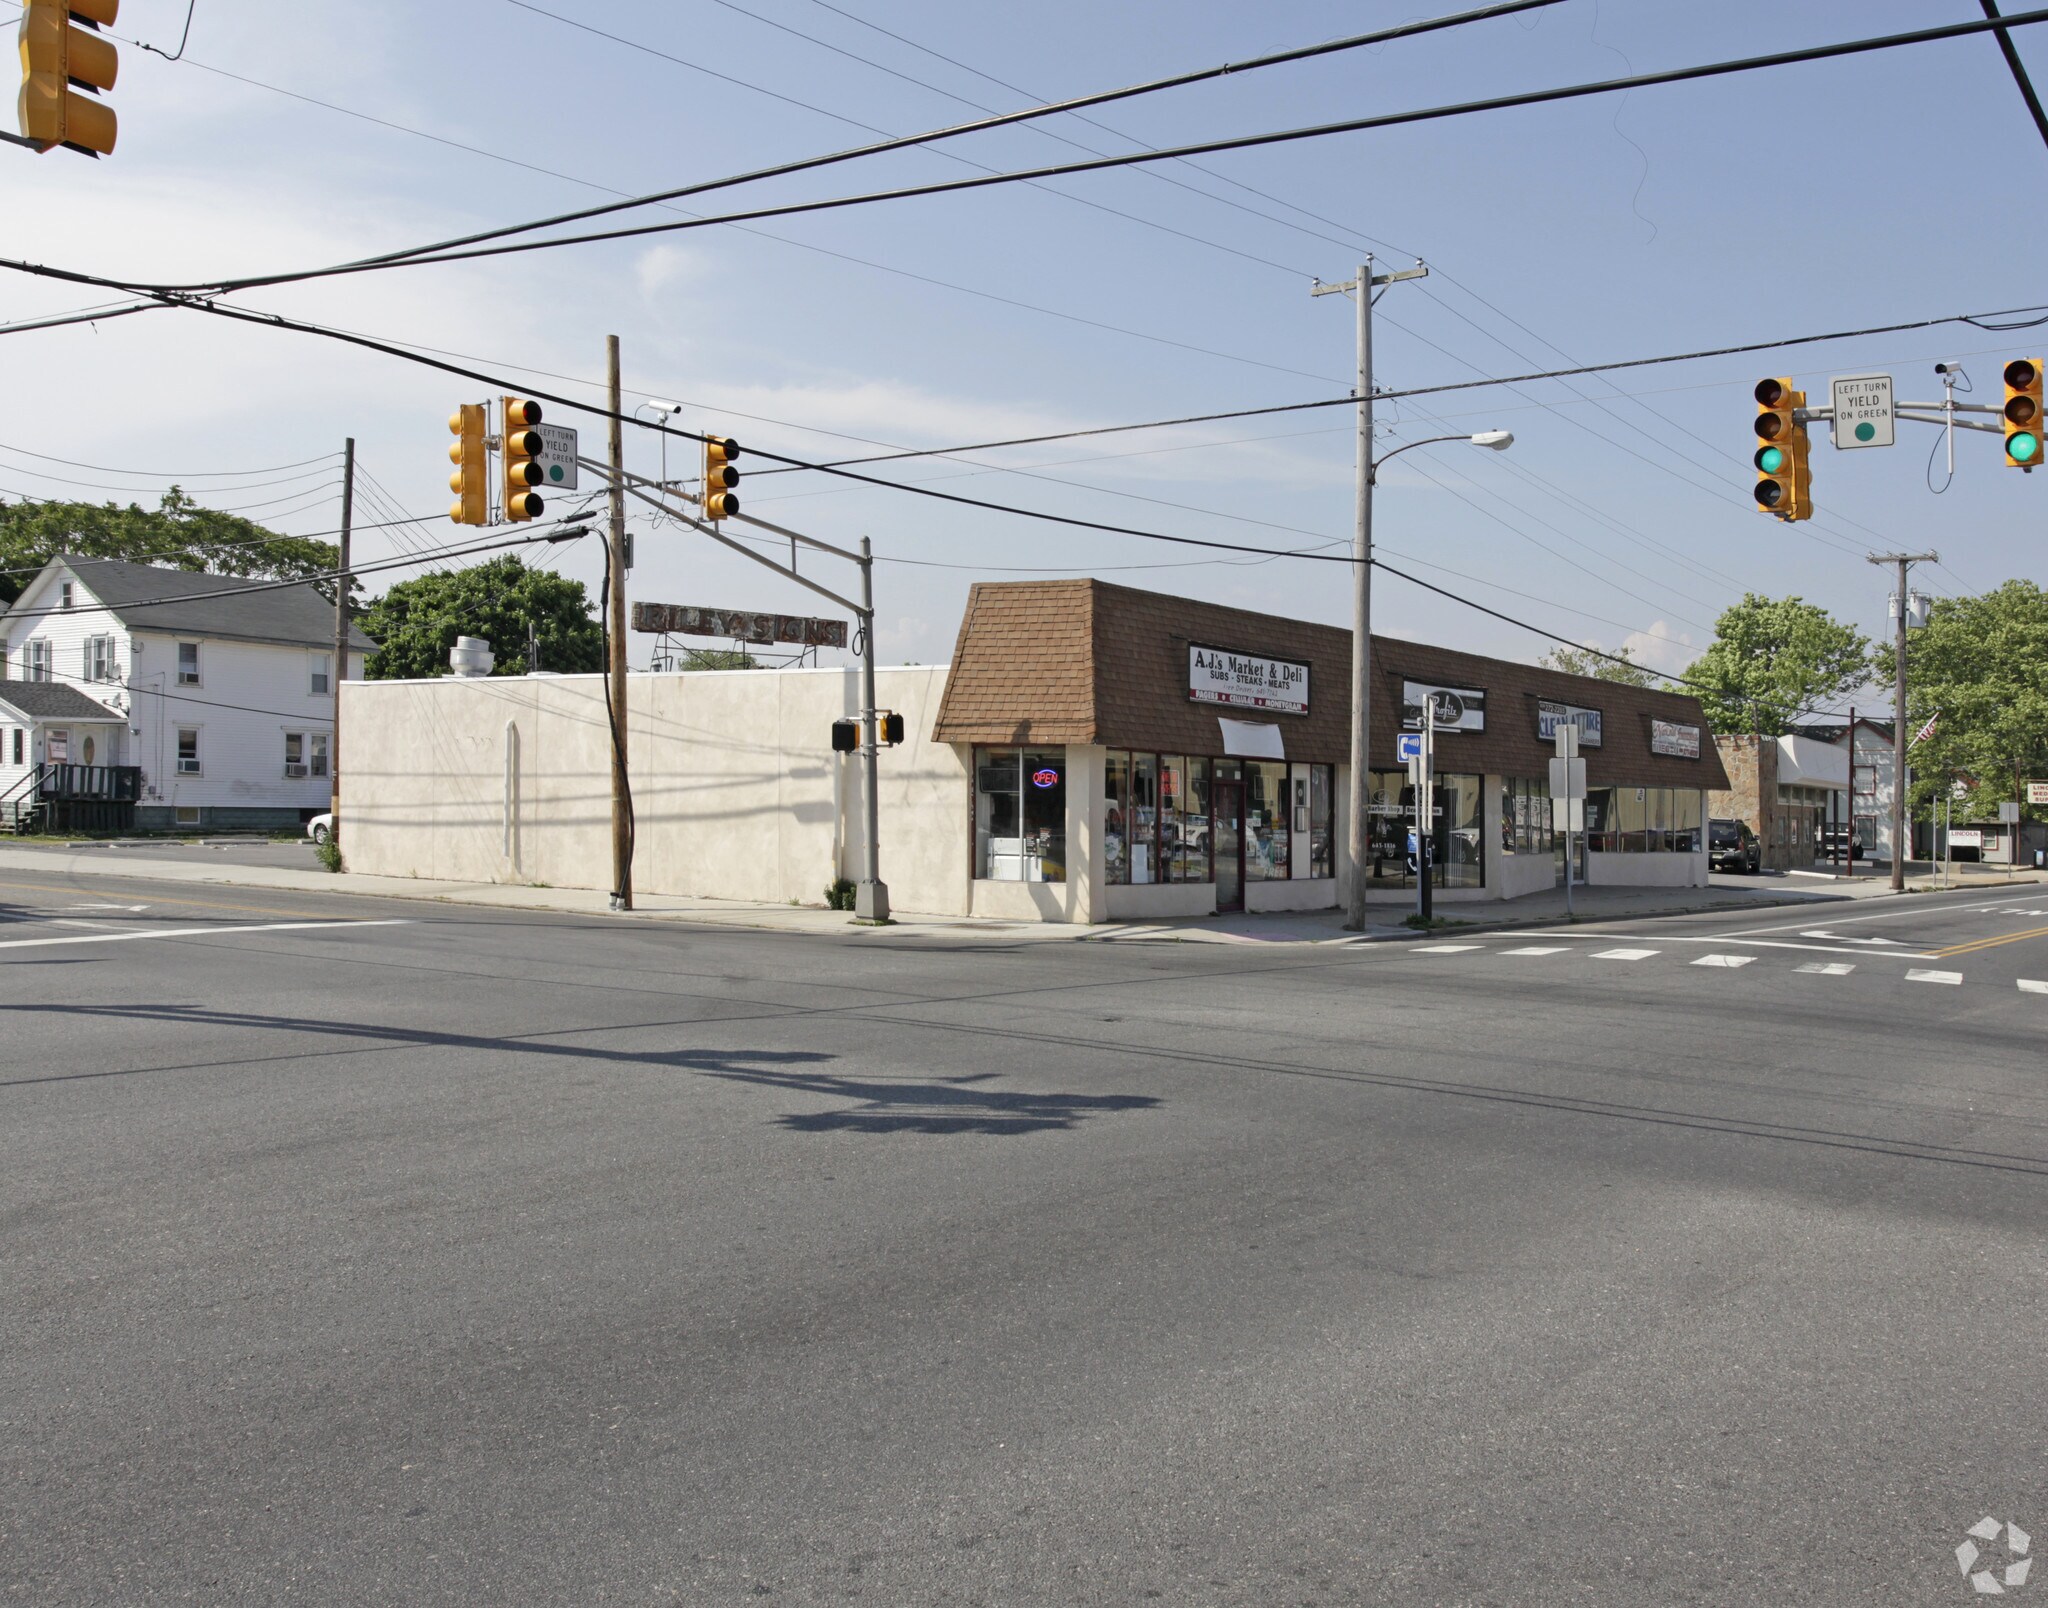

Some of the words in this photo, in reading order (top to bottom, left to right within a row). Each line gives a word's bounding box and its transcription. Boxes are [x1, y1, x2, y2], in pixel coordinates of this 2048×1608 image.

[1839, 384, 1860, 394] LEFT
[1864, 382, 1887, 392] TURN
[1848, 395, 1879, 407] YIELD
[1841, 411, 1853, 420] ON
[1858, 408, 1888, 419] GREEN
[540, 428, 555, 438] LEFT
[557, 431, 574, 441] TURN
[546, 439, 568, 453] YIELD
[540, 451, 549, 459] ON
[552, 453, 574, 463] GREEN
[752, 614, 841, 647] SIGNS
[1228, 656, 1263, 677] Market
[1270, 663, 1277, 679] &
[1283, 665, 1302, 682] Deli
[1210, 670, 1229, 681] SUBS
[1236, 674, 1263, 686] STEAKS
[1269, 679, 1290, 690] MEATS
[1196, 690, 1218, 701] PAGERS
[1032, 772, 1058, 783] OPEN
